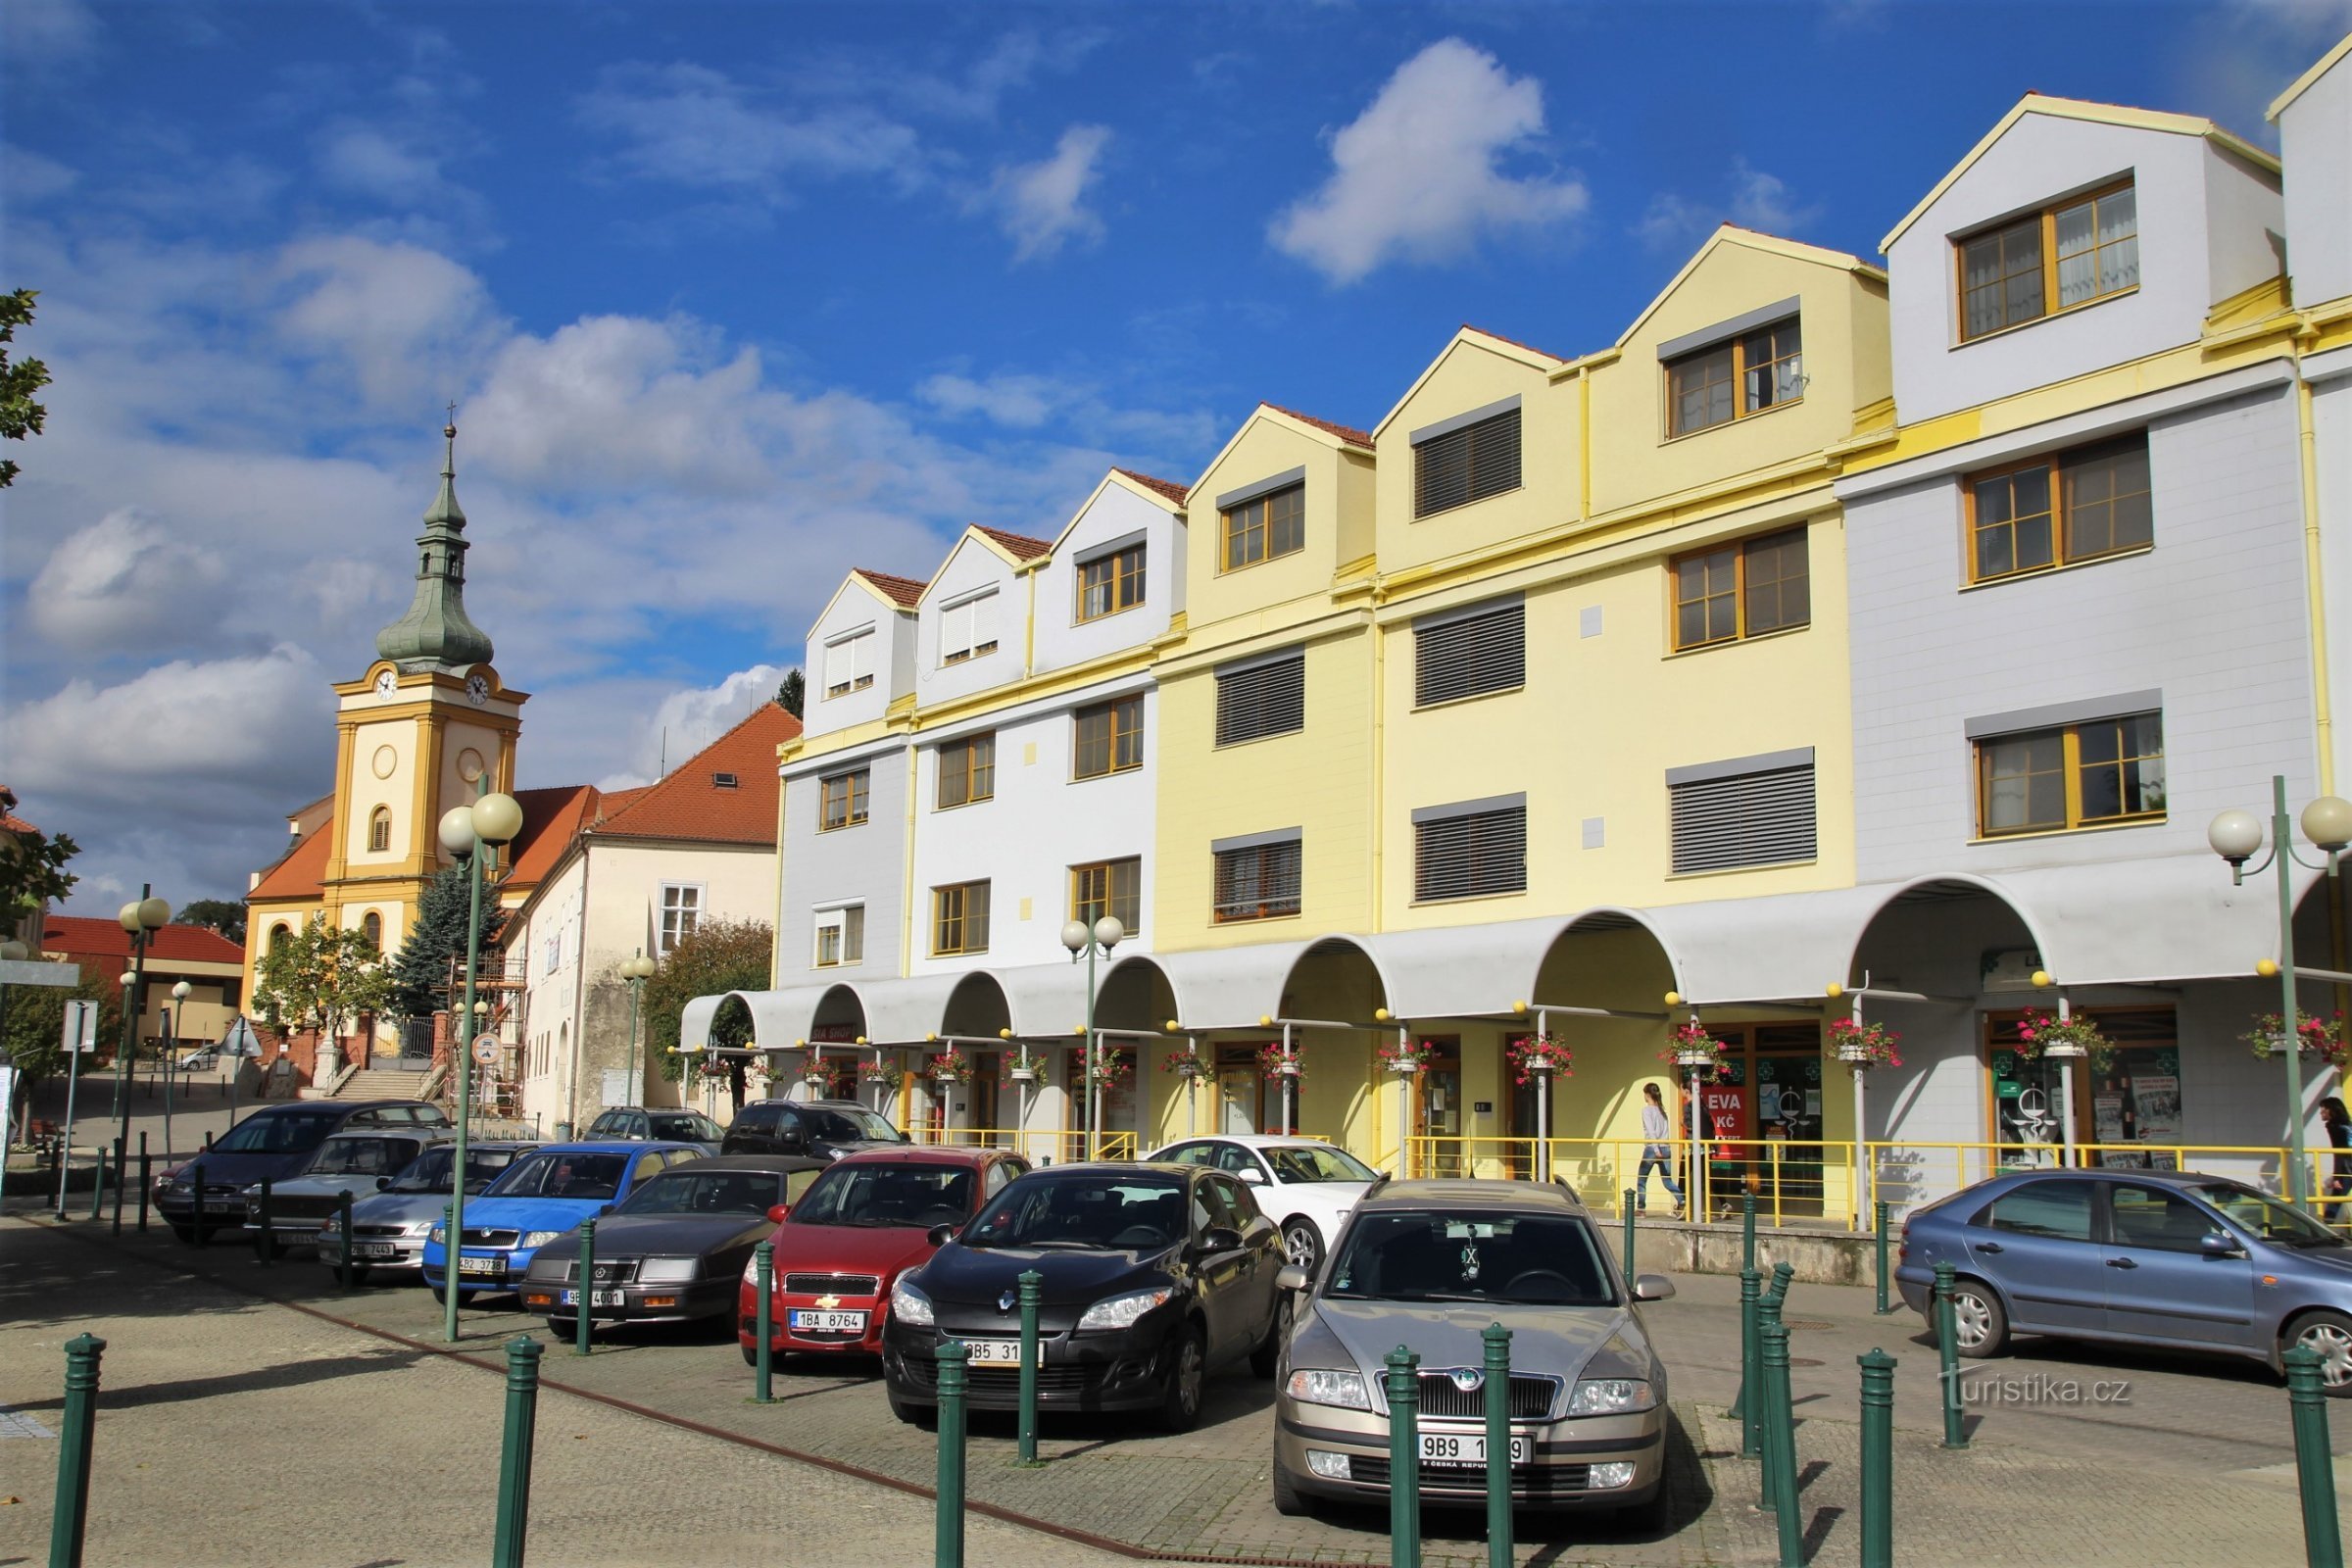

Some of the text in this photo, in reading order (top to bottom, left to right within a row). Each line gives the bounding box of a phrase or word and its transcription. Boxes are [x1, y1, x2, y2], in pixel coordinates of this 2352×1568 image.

[812, 1027, 827, 1040] SIA
[1708, 1094, 1740, 1109] EVA
[1716, 1114, 1735, 1128] KČ
[371, 1245, 390, 1254] 7443
[1465, 1248, 1477, 1264] X
[480, 1260, 502, 1271] 3738
[569, 1292, 580, 1303] 9B
[594, 1293, 619, 1303] 4001
[801, 1313, 858, 1327] 1BA 8764
[1002, 1345, 1019, 1359] 31
[1424, 1437, 1523, 1459] 9B9 19
[1430, 1459, 1457, 1468] ČESKÁ
